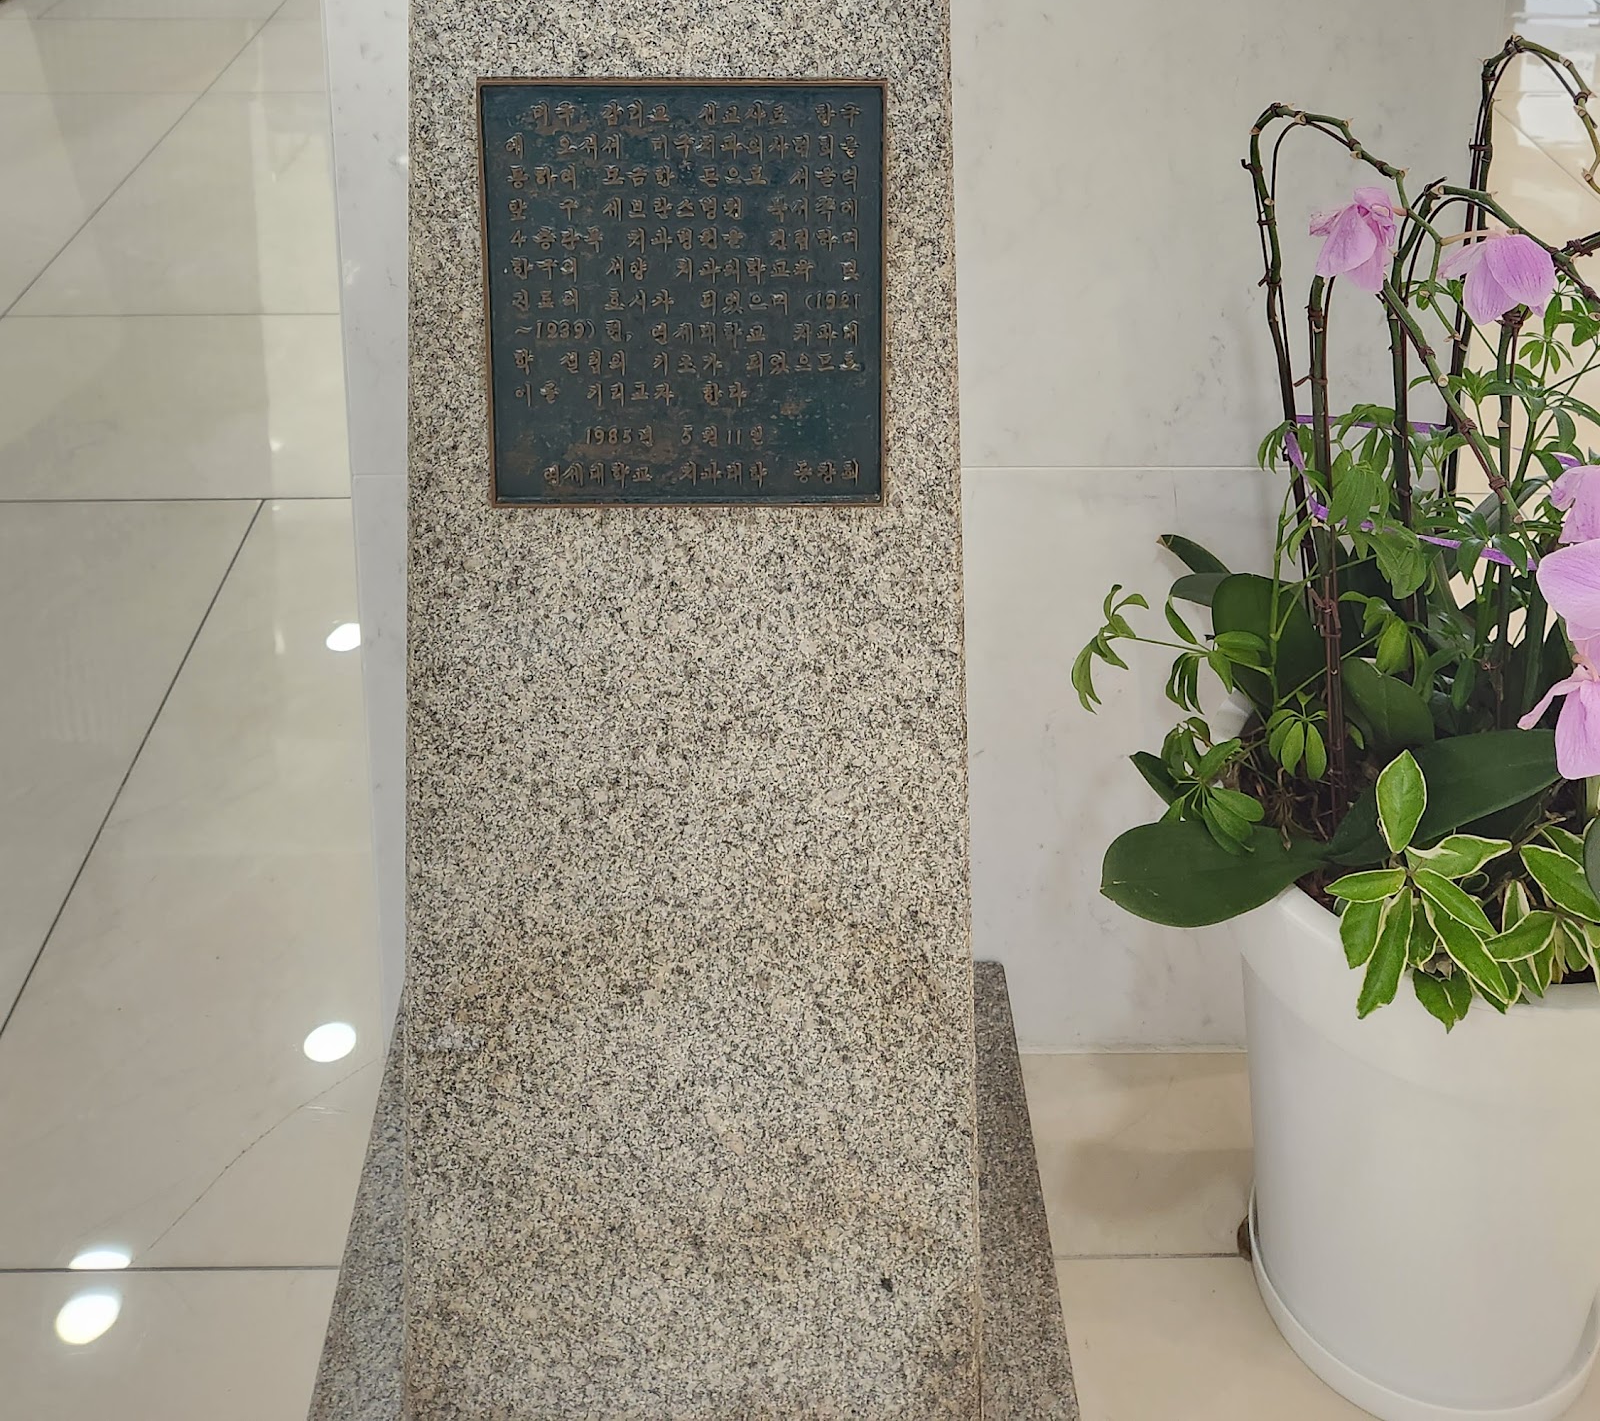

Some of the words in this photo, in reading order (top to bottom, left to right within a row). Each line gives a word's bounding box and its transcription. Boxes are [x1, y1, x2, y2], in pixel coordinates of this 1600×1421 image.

[530, 99, 577, 127] 미국
[698, 99, 790, 127] 선교사로
[815, 101, 862, 128] 한국
[602, 164, 676, 189] 모금한
[699, 164, 769, 189] 돈으로
[789, 164, 859, 193] 서울역
[559, 196, 579, 221] 구
[602, 195, 742, 222] 세브란스병원
[510, 256, 578, 283] 한국의
[606, 256, 648, 283] 서양
[675, 256, 815, 285] 치과의학교육
[512, 286, 580, 314] 진료의
[604, 287, 675, 315] 효시가
[700, 289, 789, 316] 되었으며
[650, 320, 766, 349] 연세대학교
[513, 347, 535, 376] 학
[652, 350, 723, 377] 기초가
[515, 380, 560, 407] 이를
[586, 380, 676, 407] 기리고자
[702, 380, 748, 408] 한다
[543, 460, 653, 489] 연세대학교
[678, 459, 769, 489] 치과대학
